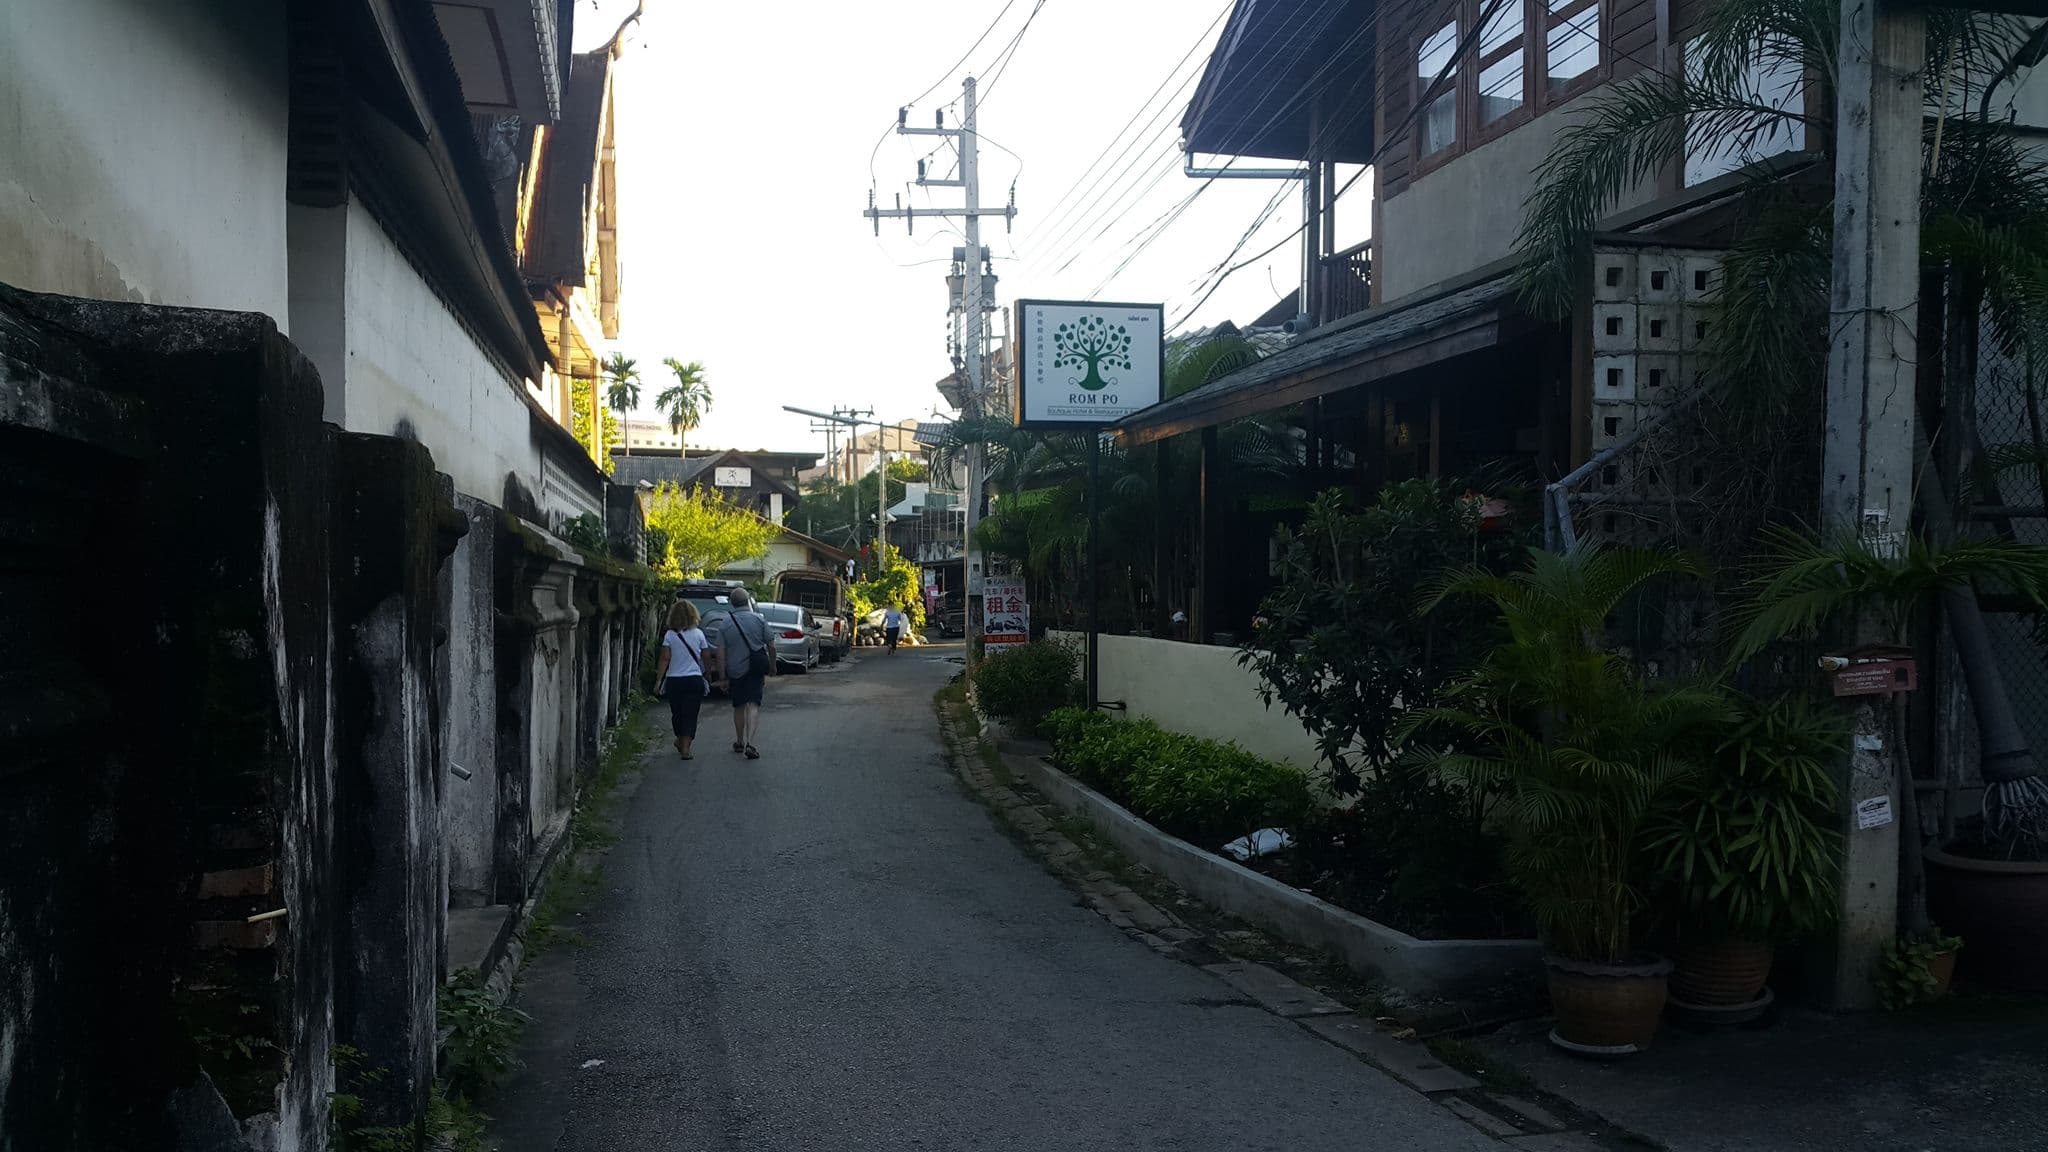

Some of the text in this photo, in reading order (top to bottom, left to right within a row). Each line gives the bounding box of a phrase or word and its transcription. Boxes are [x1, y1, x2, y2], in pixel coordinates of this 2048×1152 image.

[1069, 394, 1118, 405] ROM PO
[986, 596, 1023, 614] 租金
